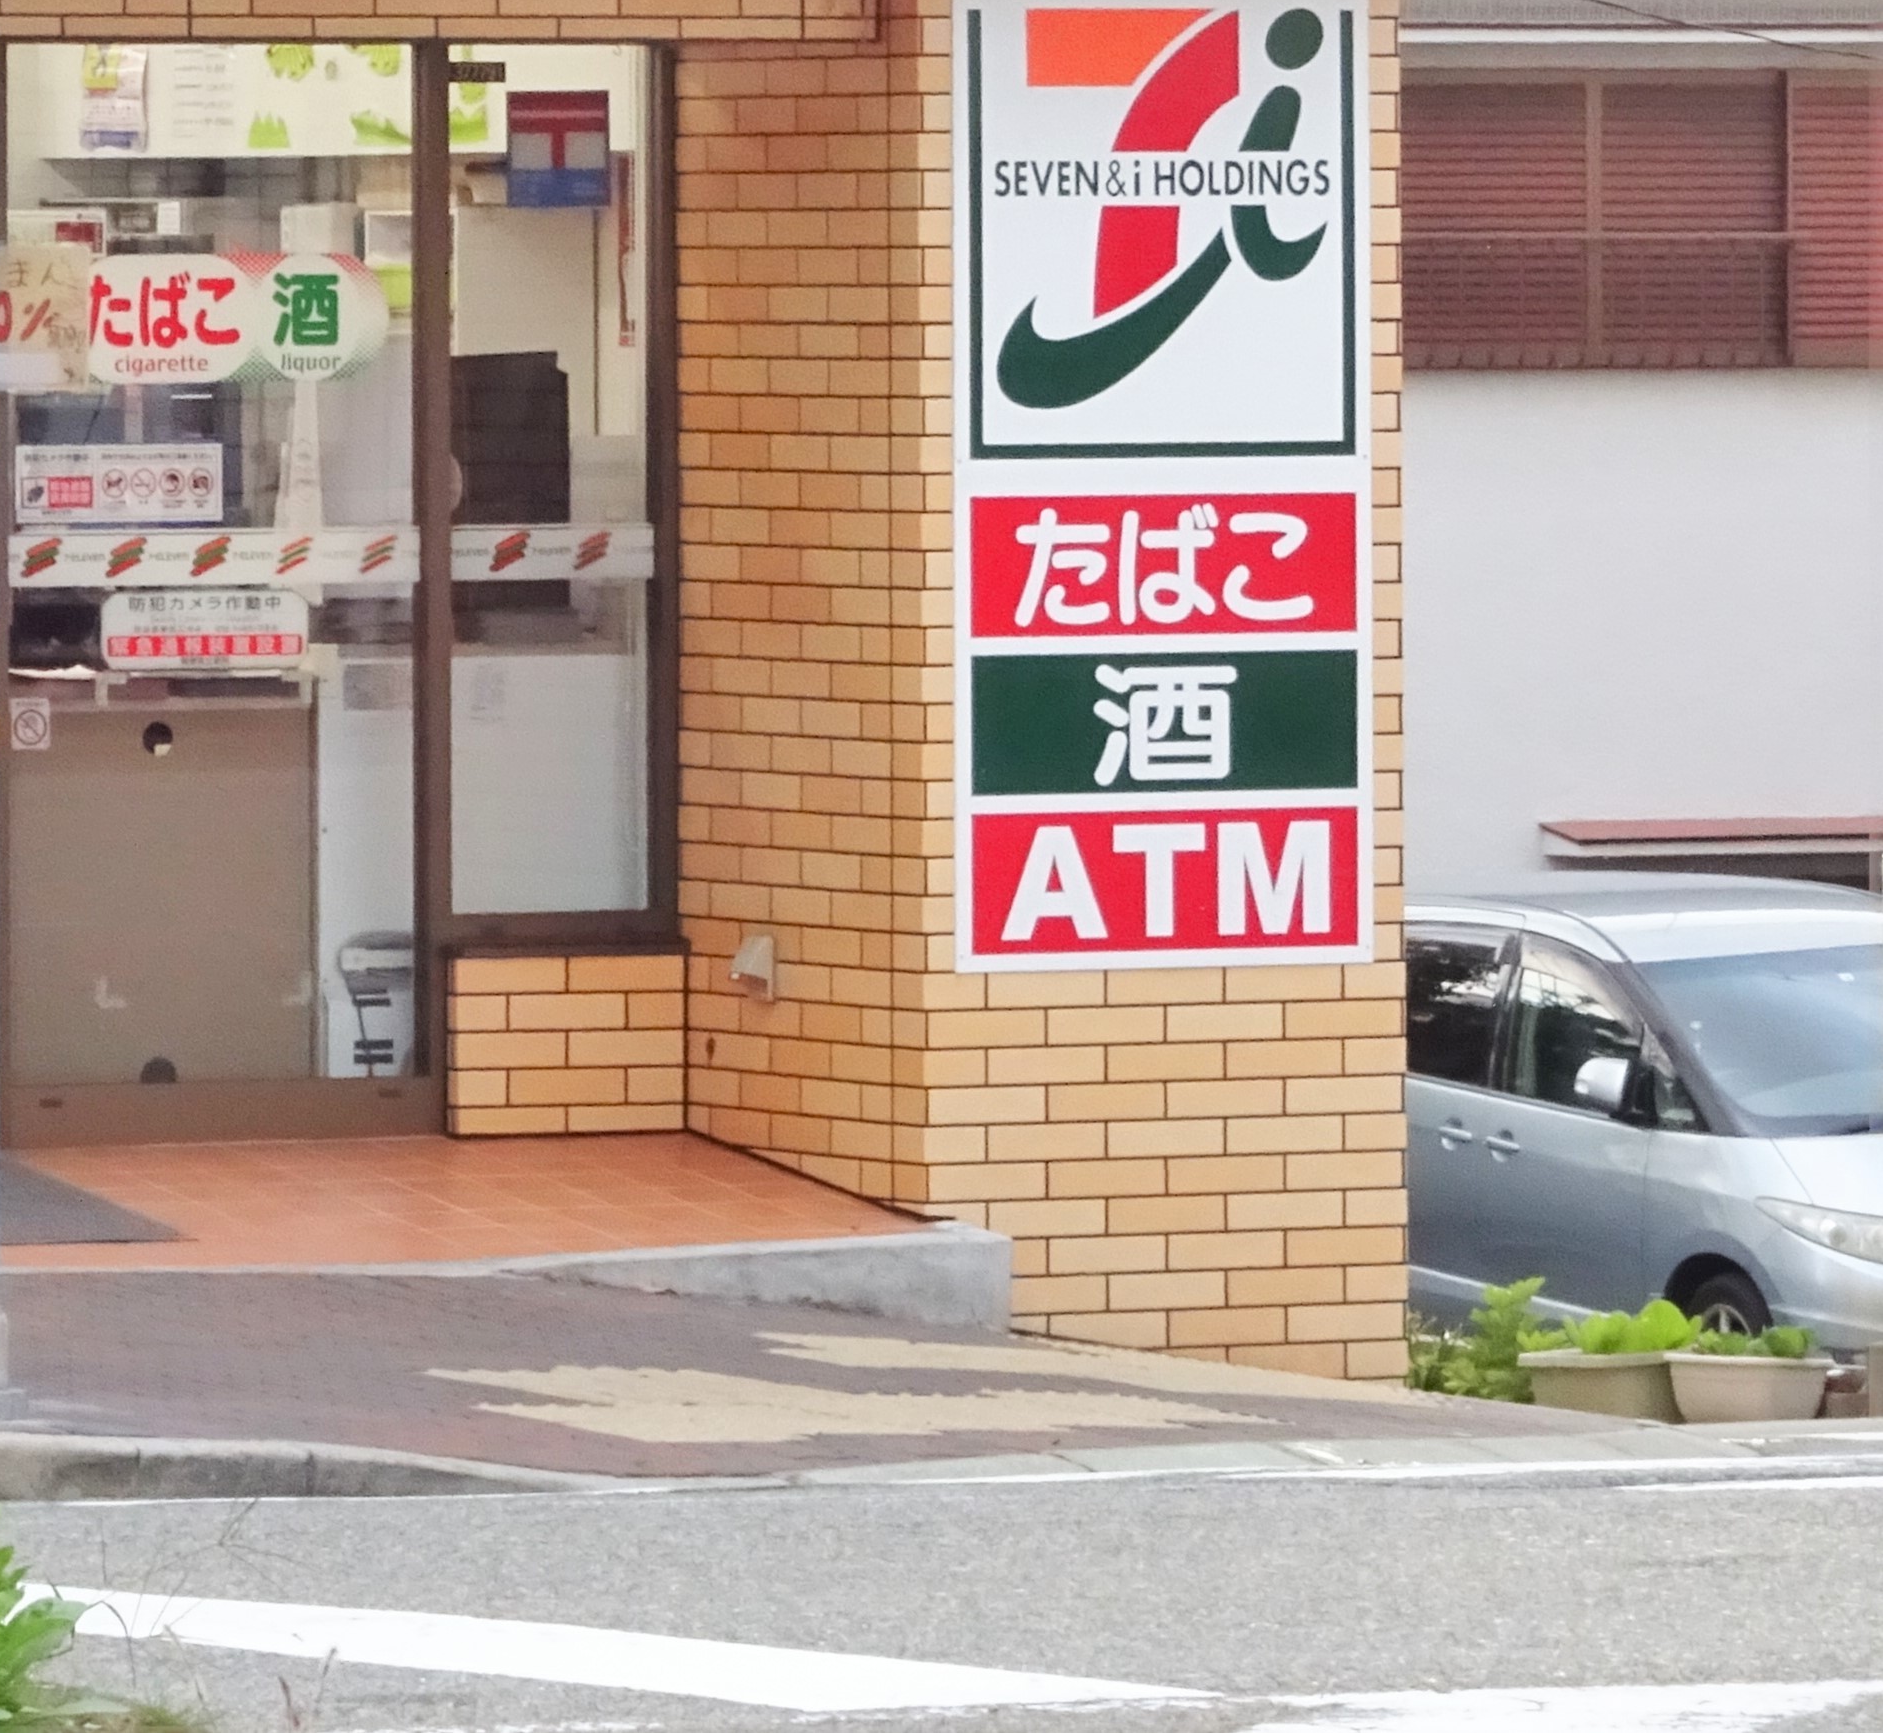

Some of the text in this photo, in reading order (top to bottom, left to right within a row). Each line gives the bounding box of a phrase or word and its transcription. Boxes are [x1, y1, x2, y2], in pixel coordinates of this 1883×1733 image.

[1153, 158, 1332, 199] HOLDINGS
[89, 271, 241, 349] たばこ
[272, 271, 340, 347] 酒
[113, 352, 342, 376] cigarette liquor
[128, 595, 282, 612] 防犯カメラ作動中
[1012, 502, 1314, 630] たばこ
[1093, 663, 1238, 786] 酒
[1000, 819, 1334, 943] ATM
